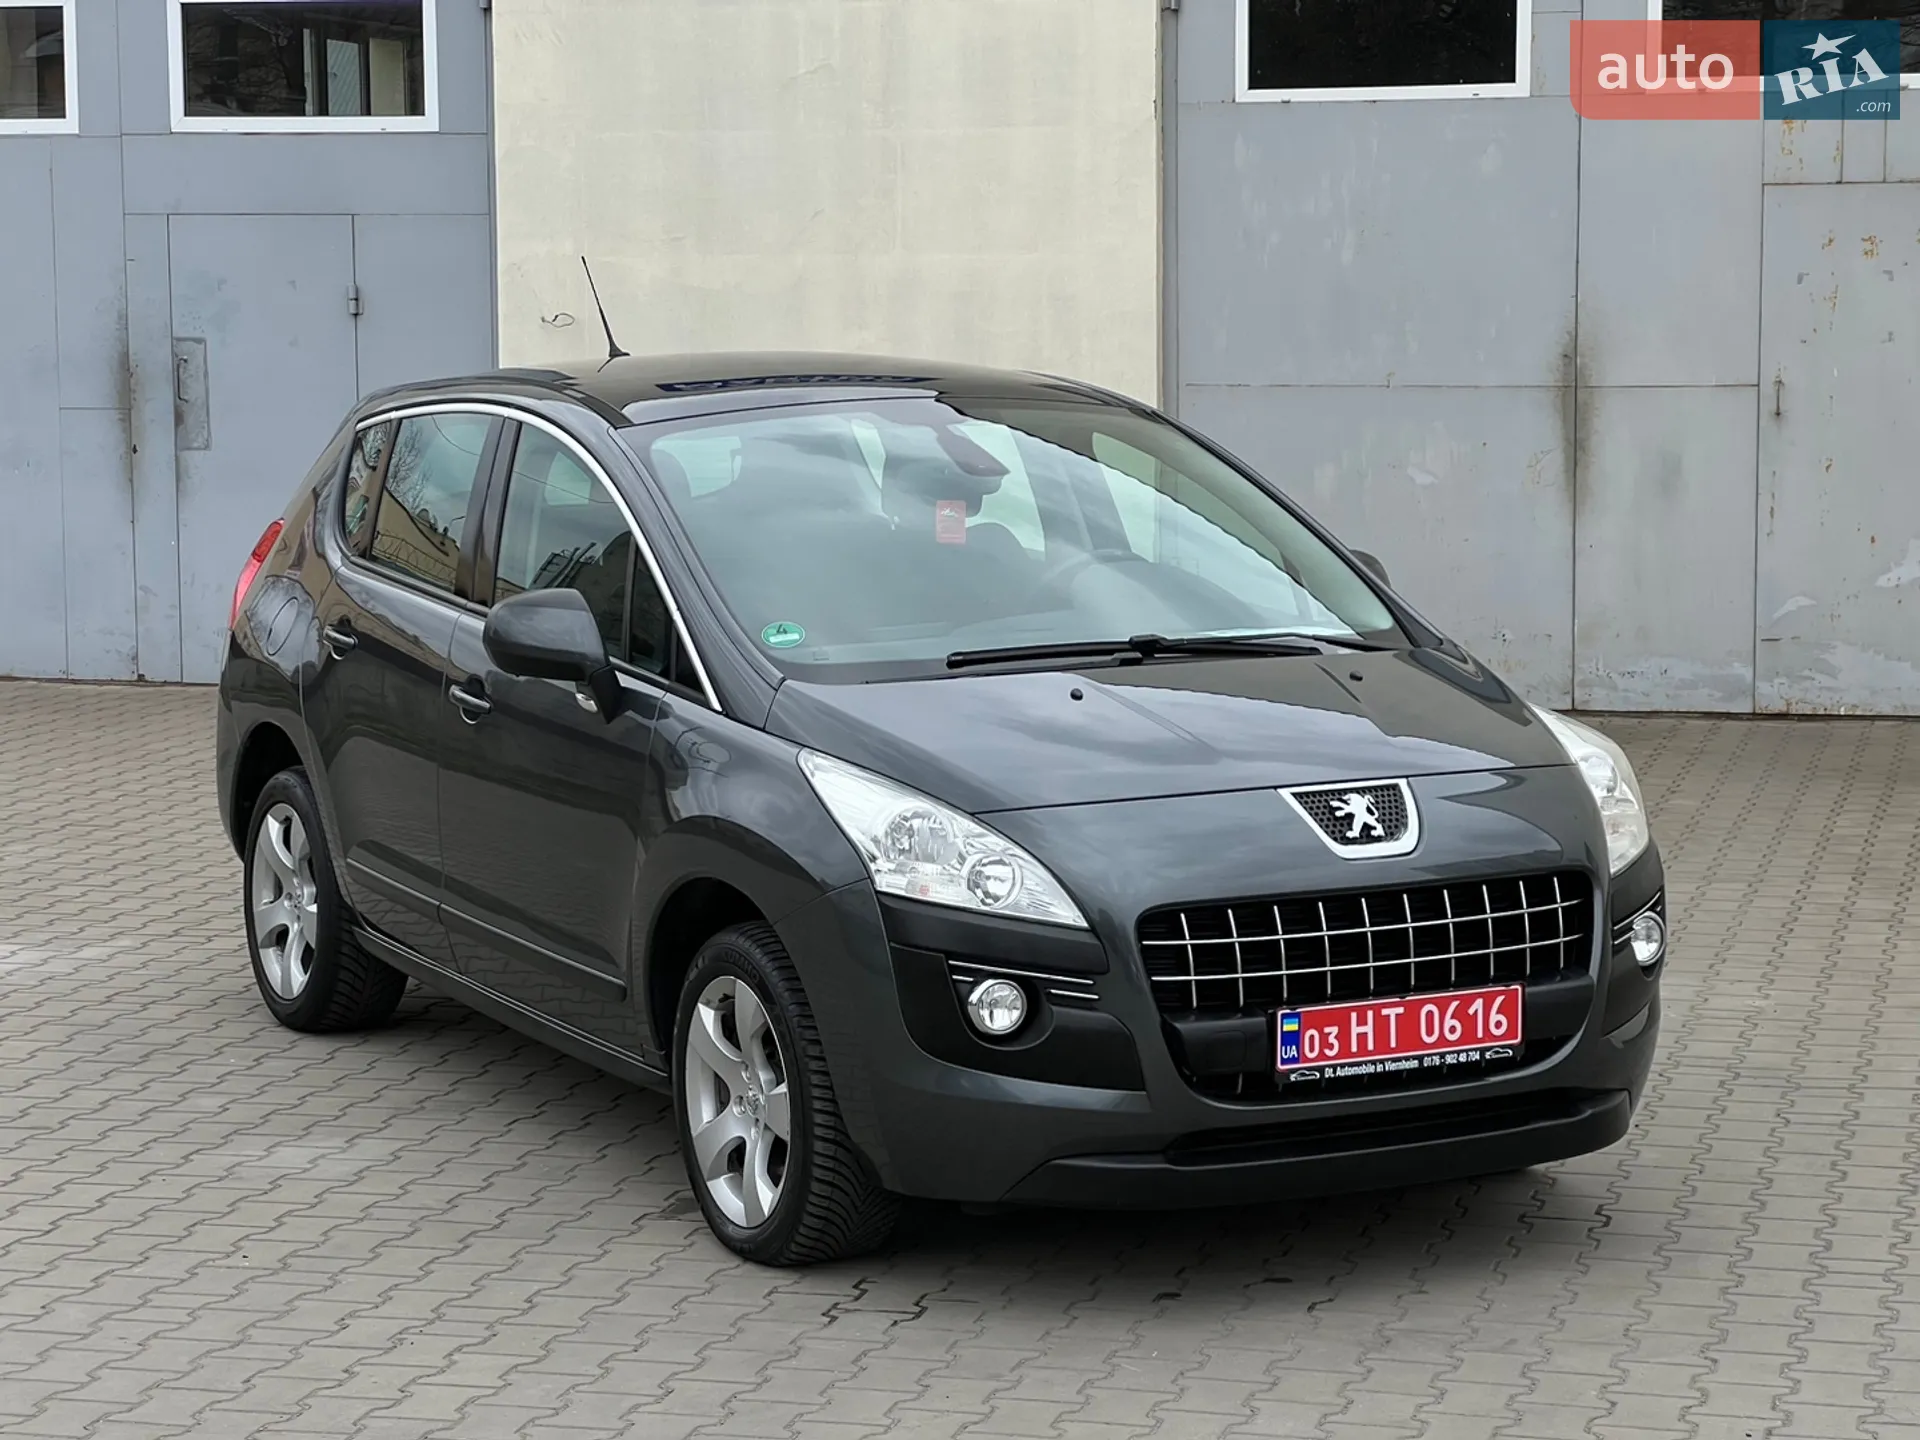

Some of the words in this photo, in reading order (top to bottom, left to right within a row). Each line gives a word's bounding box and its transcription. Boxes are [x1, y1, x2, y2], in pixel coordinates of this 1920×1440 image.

[1303, 1026, 1340, 1059] 03
[1350, 1006, 1405, 1053] HT
[1420, 994, 1508, 1045] 0616
[1281, 1045, 1298, 1059] UA
[1336, 1063, 1376, 1077] Automobile
[1376, 1061, 1384, 1073] in
